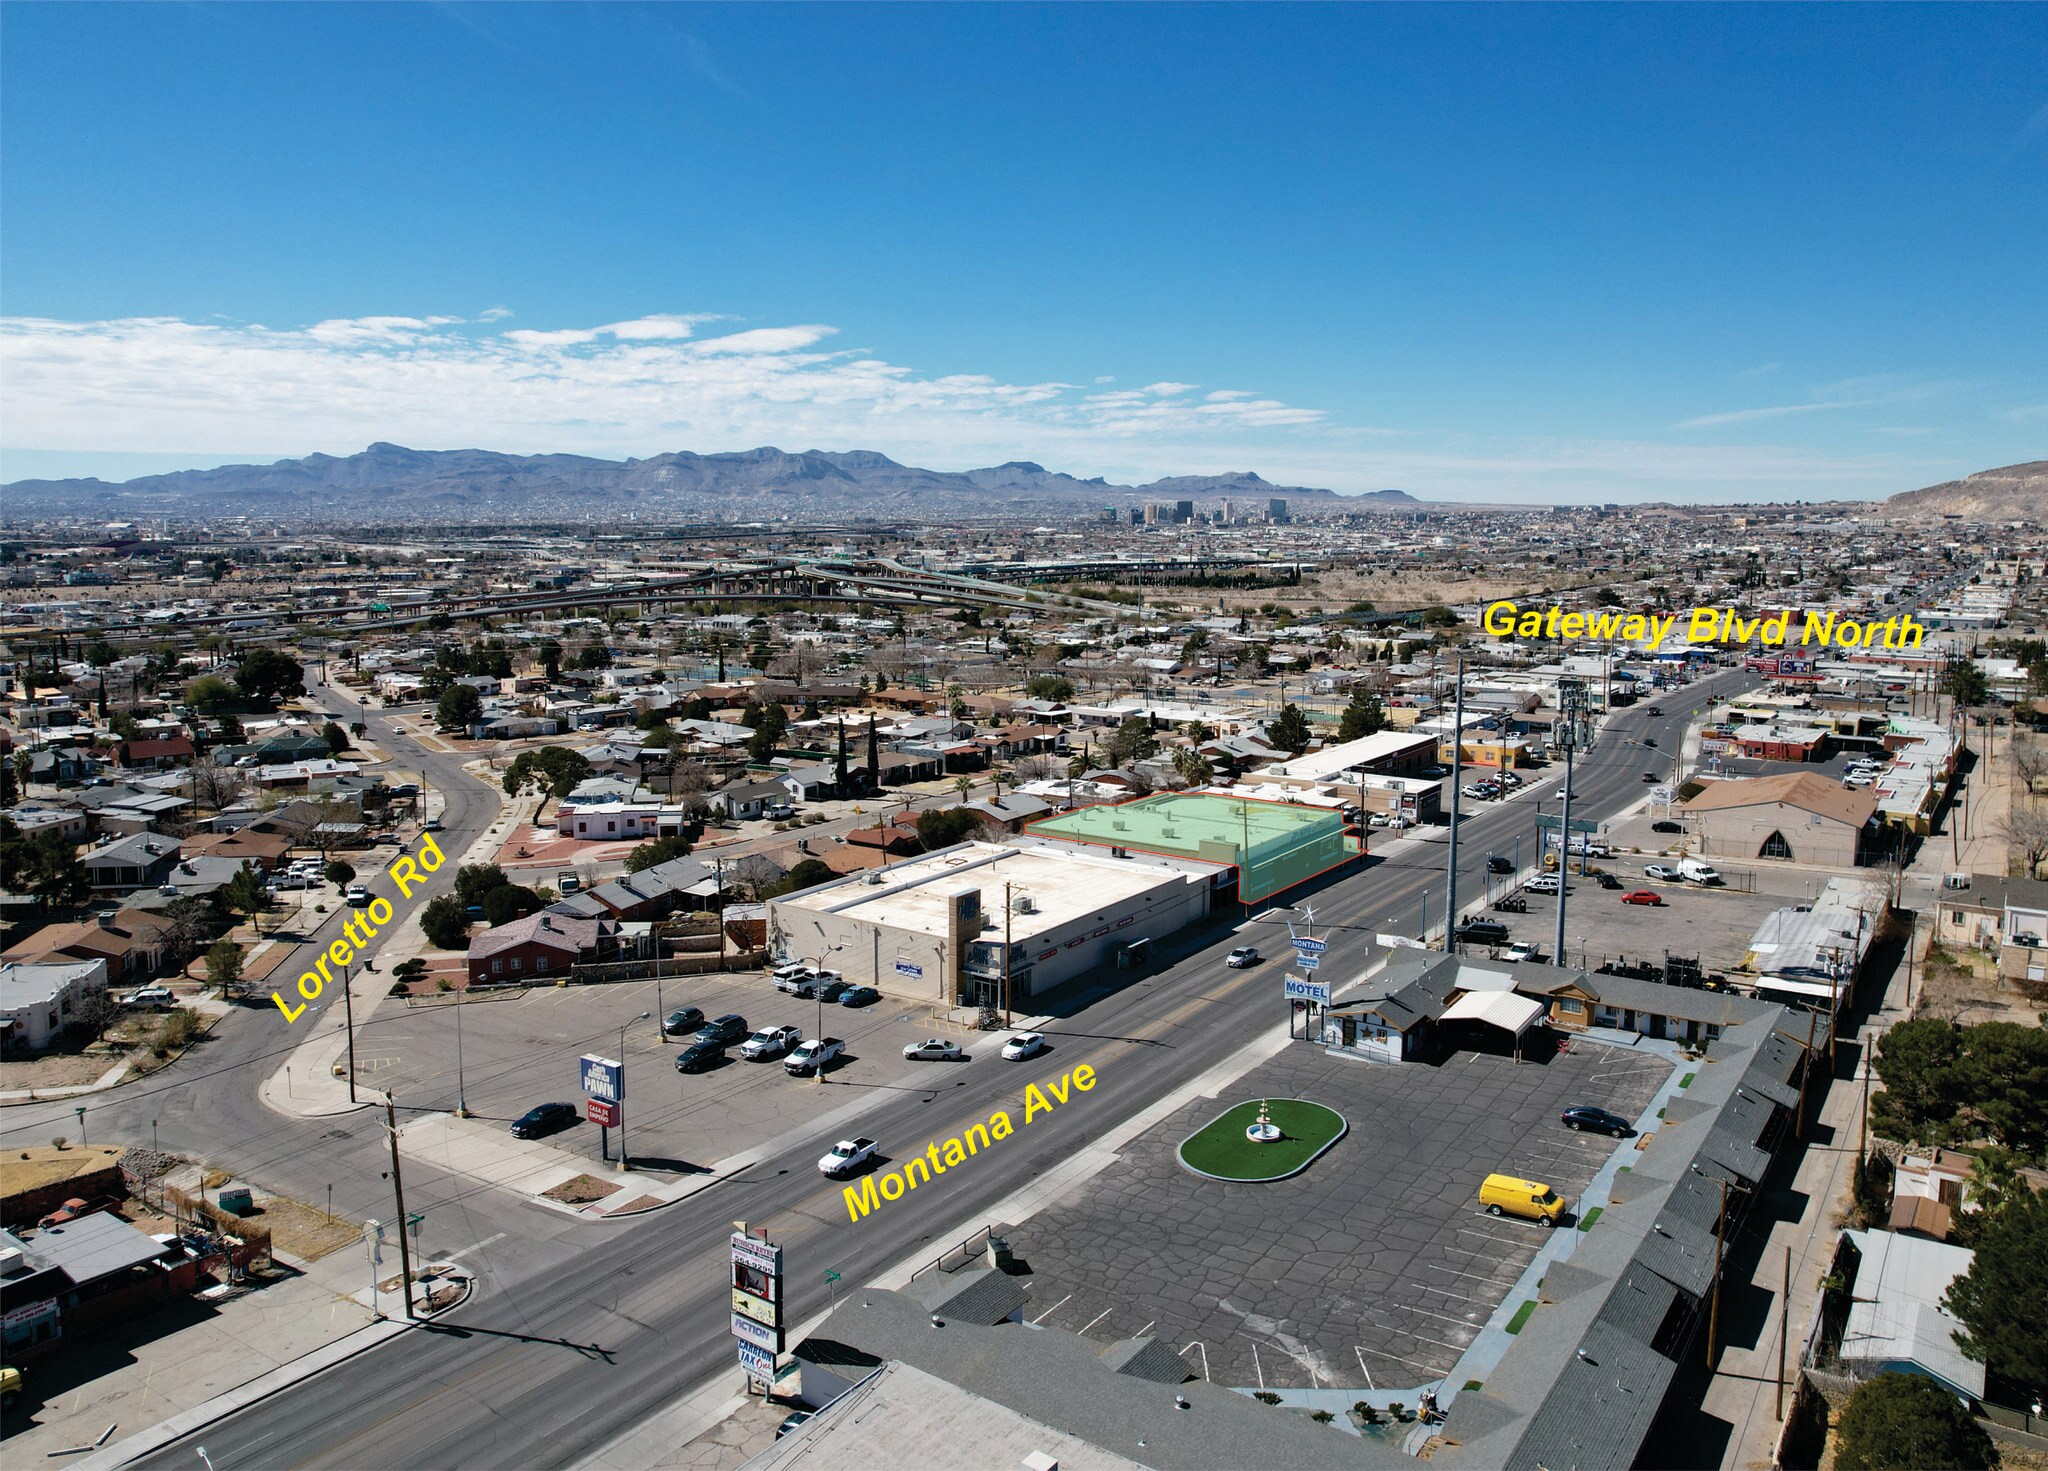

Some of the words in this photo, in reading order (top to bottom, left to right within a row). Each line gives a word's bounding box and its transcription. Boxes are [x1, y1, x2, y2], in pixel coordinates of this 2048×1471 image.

[1291, 939, 1325, 951] MONTANA
[1286, 982, 1327, 998] MOTEL
[588, 1069, 610, 1082] America
[592, 1063, 606, 1075] Cash
[584, 1076, 614, 1098] PAWN
[589, 1104, 602, 1114] CASA
[732, 1237, 755, 1251] EUNICE
[755, 1247, 774, 1258] REYES
[734, 1255, 773, 1274] 564-9299
[20, 1303, 44, 1315] MONTANA
[735, 1318, 770, 1340] ACTION
[738, 1339, 773, 1362] CARREON
[740, 1351, 756, 1366] TAX
[756, 1358, 771, 1370] One
